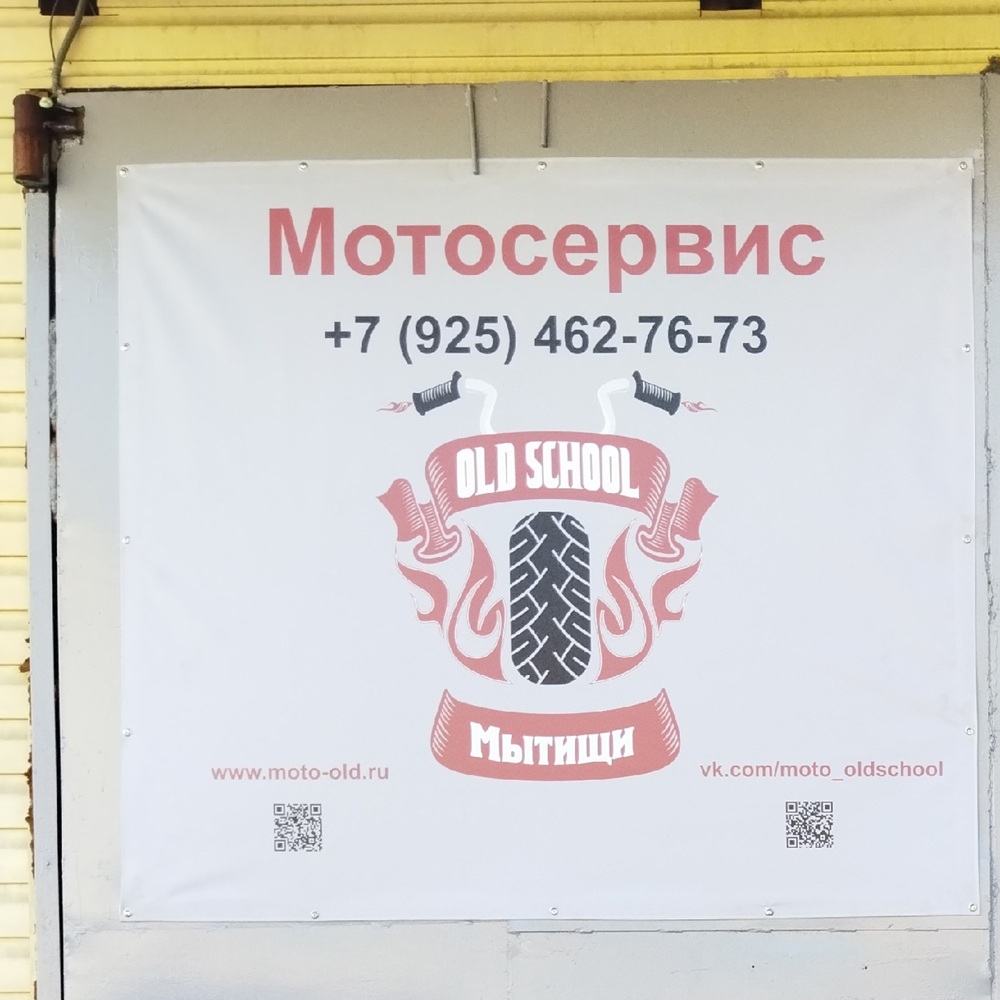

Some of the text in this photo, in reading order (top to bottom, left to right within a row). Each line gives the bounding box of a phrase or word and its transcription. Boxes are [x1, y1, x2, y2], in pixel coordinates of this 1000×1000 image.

[268, 207, 826, 293] Мотосервис
[325, 315, 768, 365] +7 (925) 462-76-73
[456, 440, 640, 499] OLD SCHOOL
[469, 721, 635, 766] Мытищи
[211, 763, 389, 780] www.moto-old.ru
[700, 761, 944, 781] vk.com/moto_oldschool
